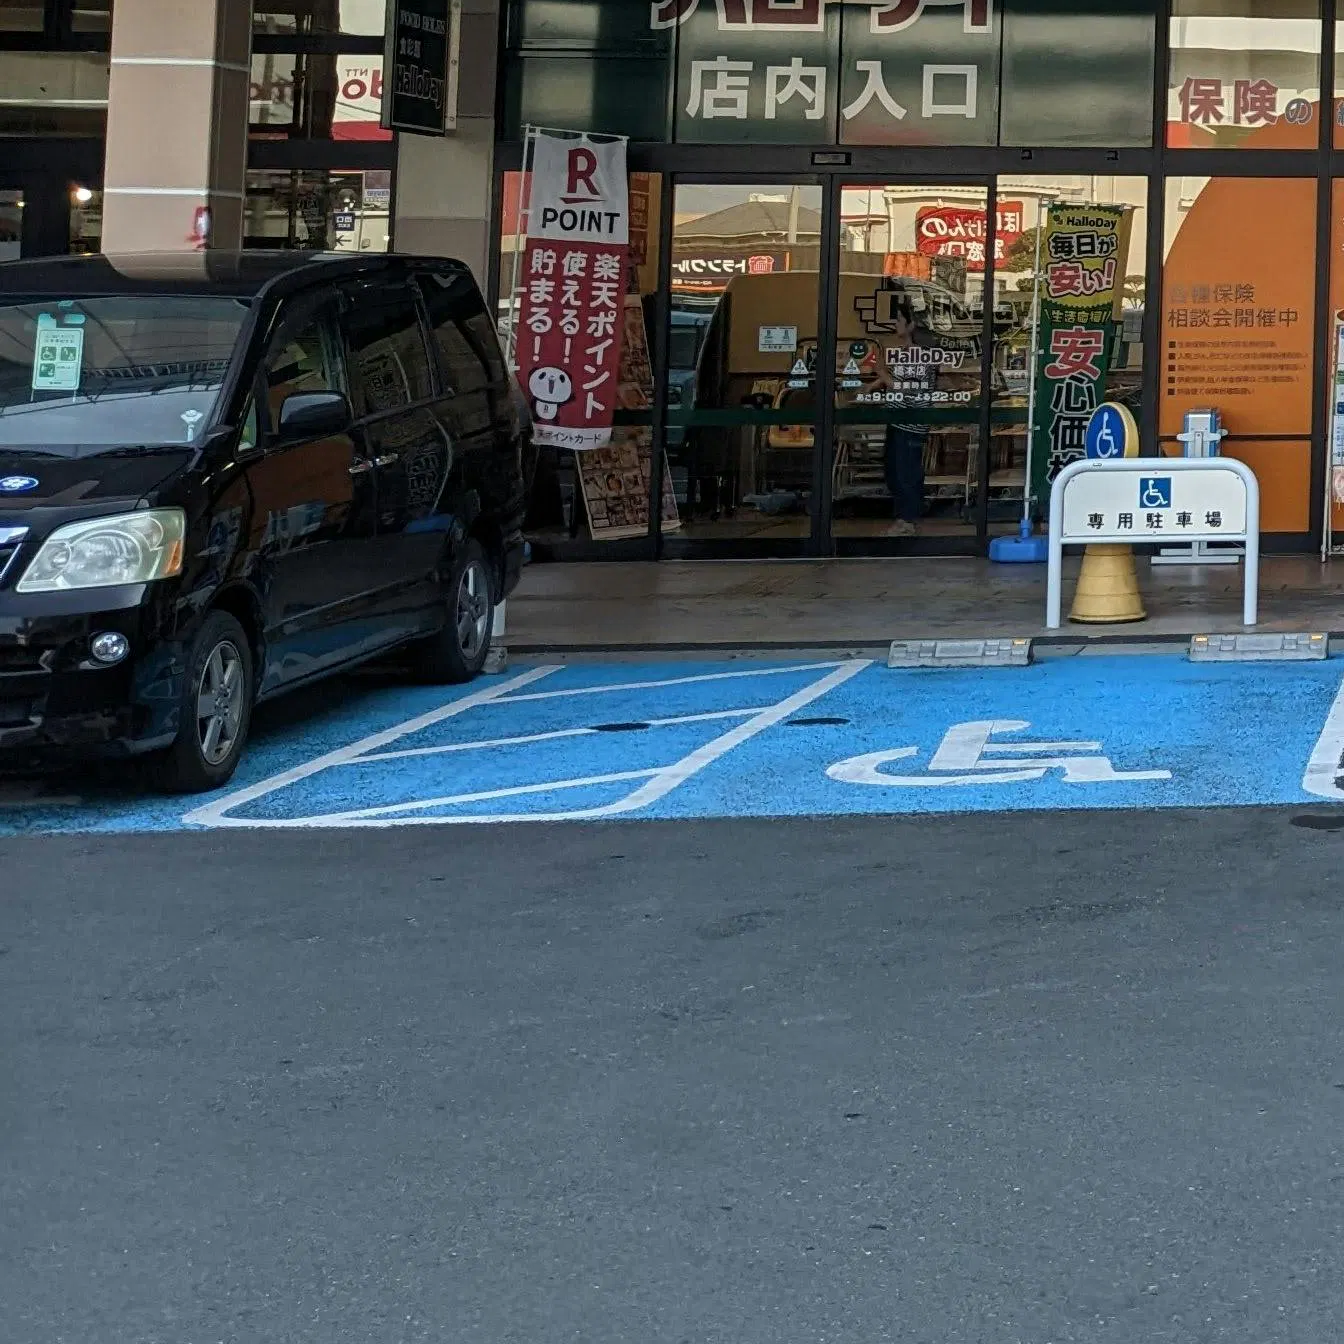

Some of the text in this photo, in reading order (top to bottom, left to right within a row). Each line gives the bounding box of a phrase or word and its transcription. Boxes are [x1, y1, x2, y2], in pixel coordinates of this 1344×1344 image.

[686, 56, 978, 120] 店内入口
[1178, 76, 1312, 126] 保険の
[541, 207, 620, 233] POINT
[1067, 216, 1117, 230] HalloDay
[1050, 232, 1117, 258] 毎日が
[1048, 259, 1116, 297] 安い!
[1168, 307, 1299, 328] 相談会開催中
[582, 253, 621, 419] 楽天ポイント
[886, 347, 965, 368] HalloDay
[1088, 511, 1223, 529] 専用駐車場
